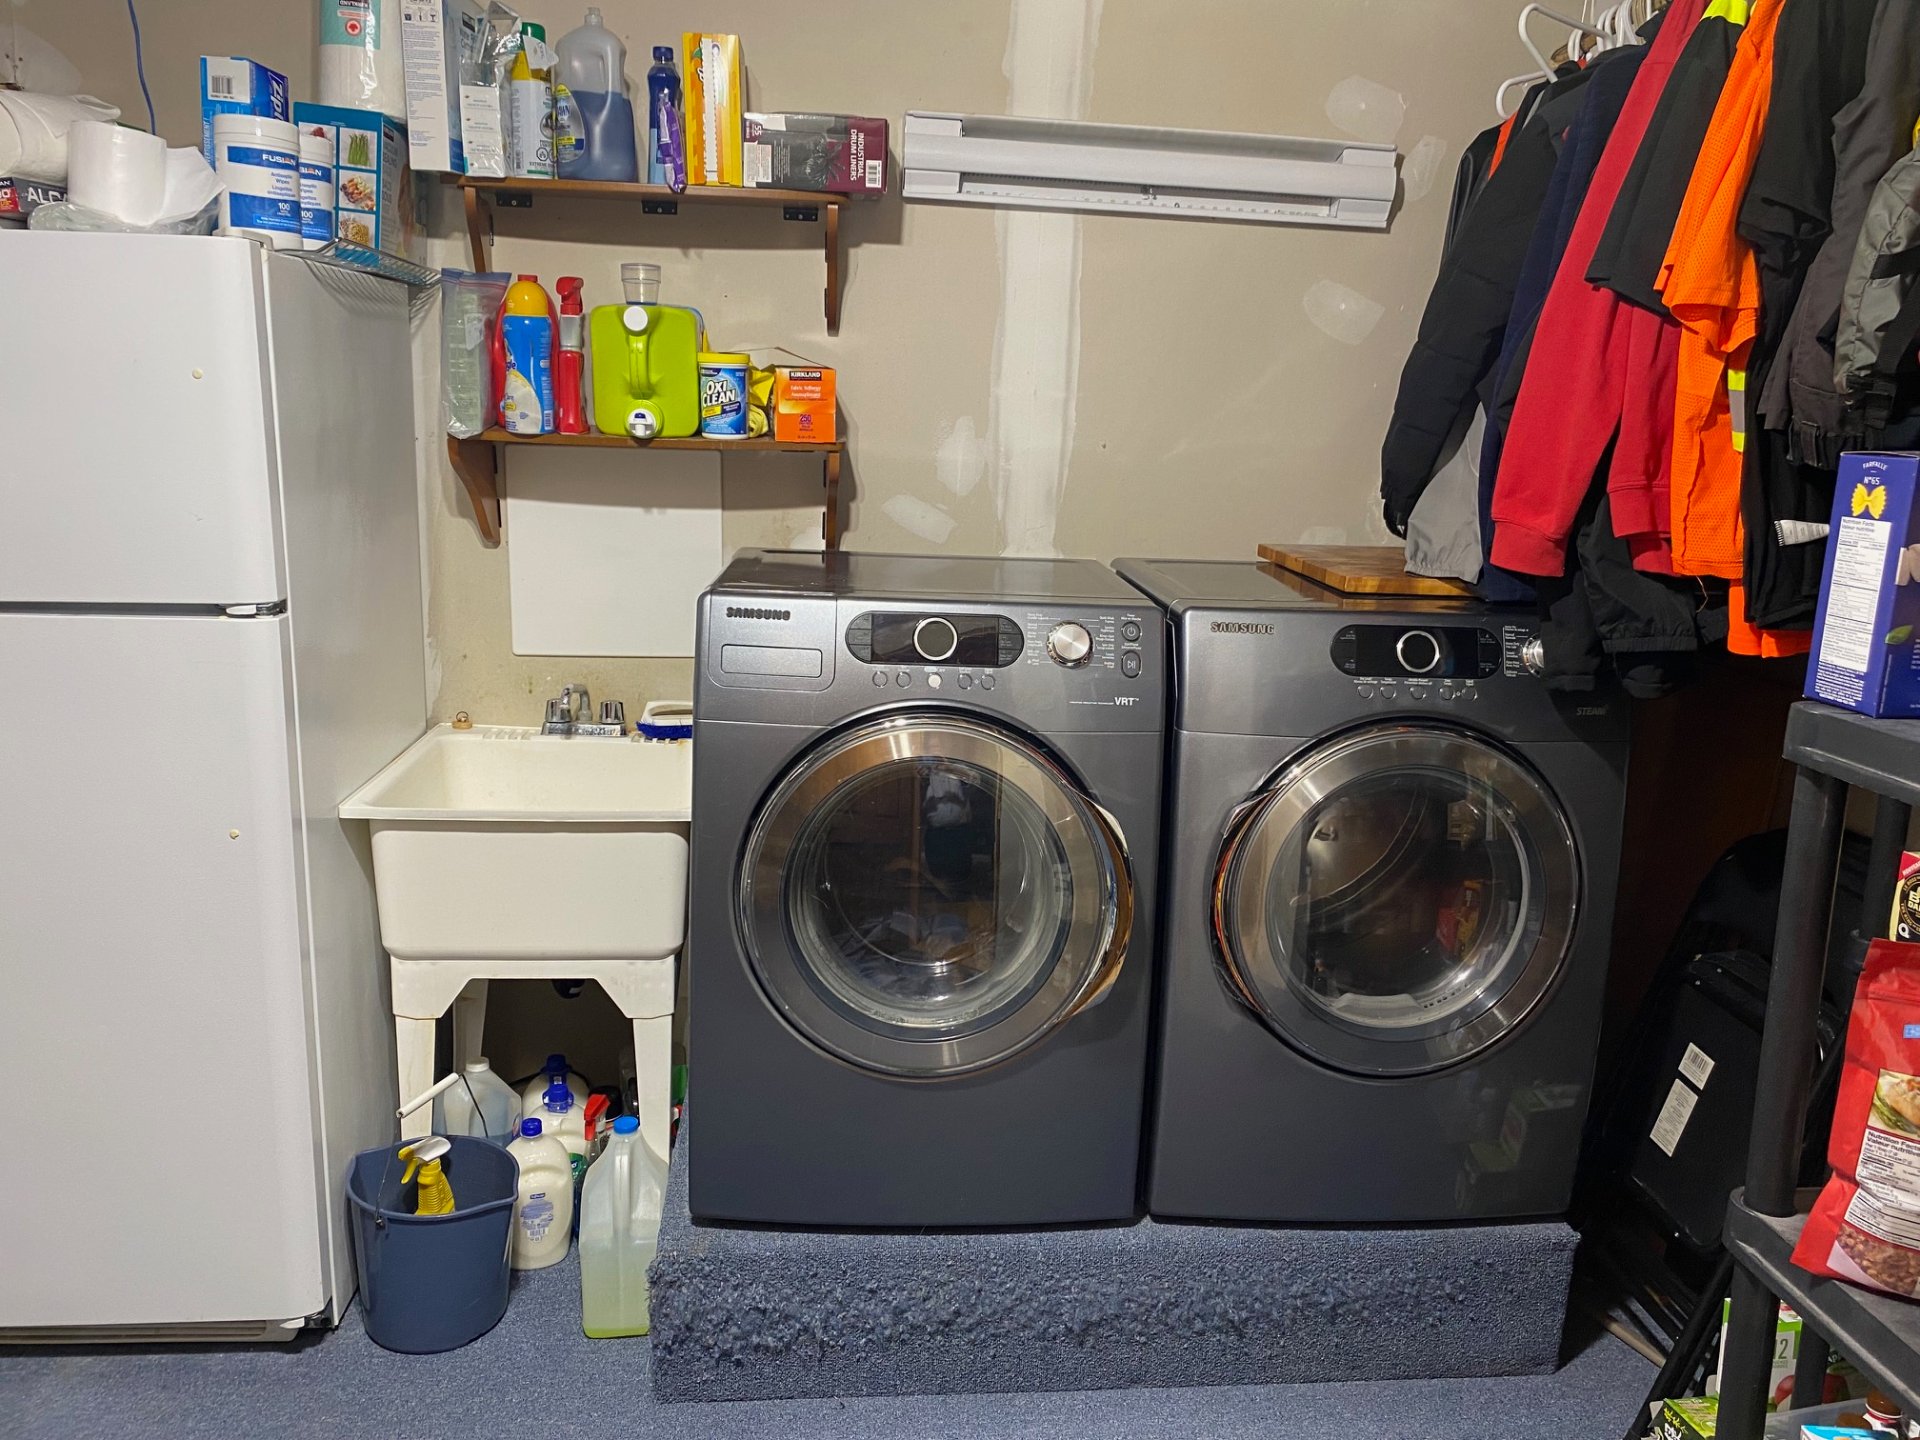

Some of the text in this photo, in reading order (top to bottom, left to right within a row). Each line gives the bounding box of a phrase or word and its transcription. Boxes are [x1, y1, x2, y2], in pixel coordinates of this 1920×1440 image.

[850, 129, 858, 181] DRUM LINERS
[857, 132, 865, 178] INDUSTRIAL
[278, 202, 291, 211] 100
[301, 210, 314, 219] 100
[706, 380, 728, 395] OXI
[702, 389, 736, 407] CLEAN
[1862, 460, 1889, 471] FARFALLE
[726, 606, 791, 621] SAMSUNG
[1210, 621, 1275, 635] SAMSUNG
[1576, 706, 1607, 716] STEAM
[1867, 1136, 1890, 1148] Valeur
[1868, 1130, 1899, 1145] Nutrition
